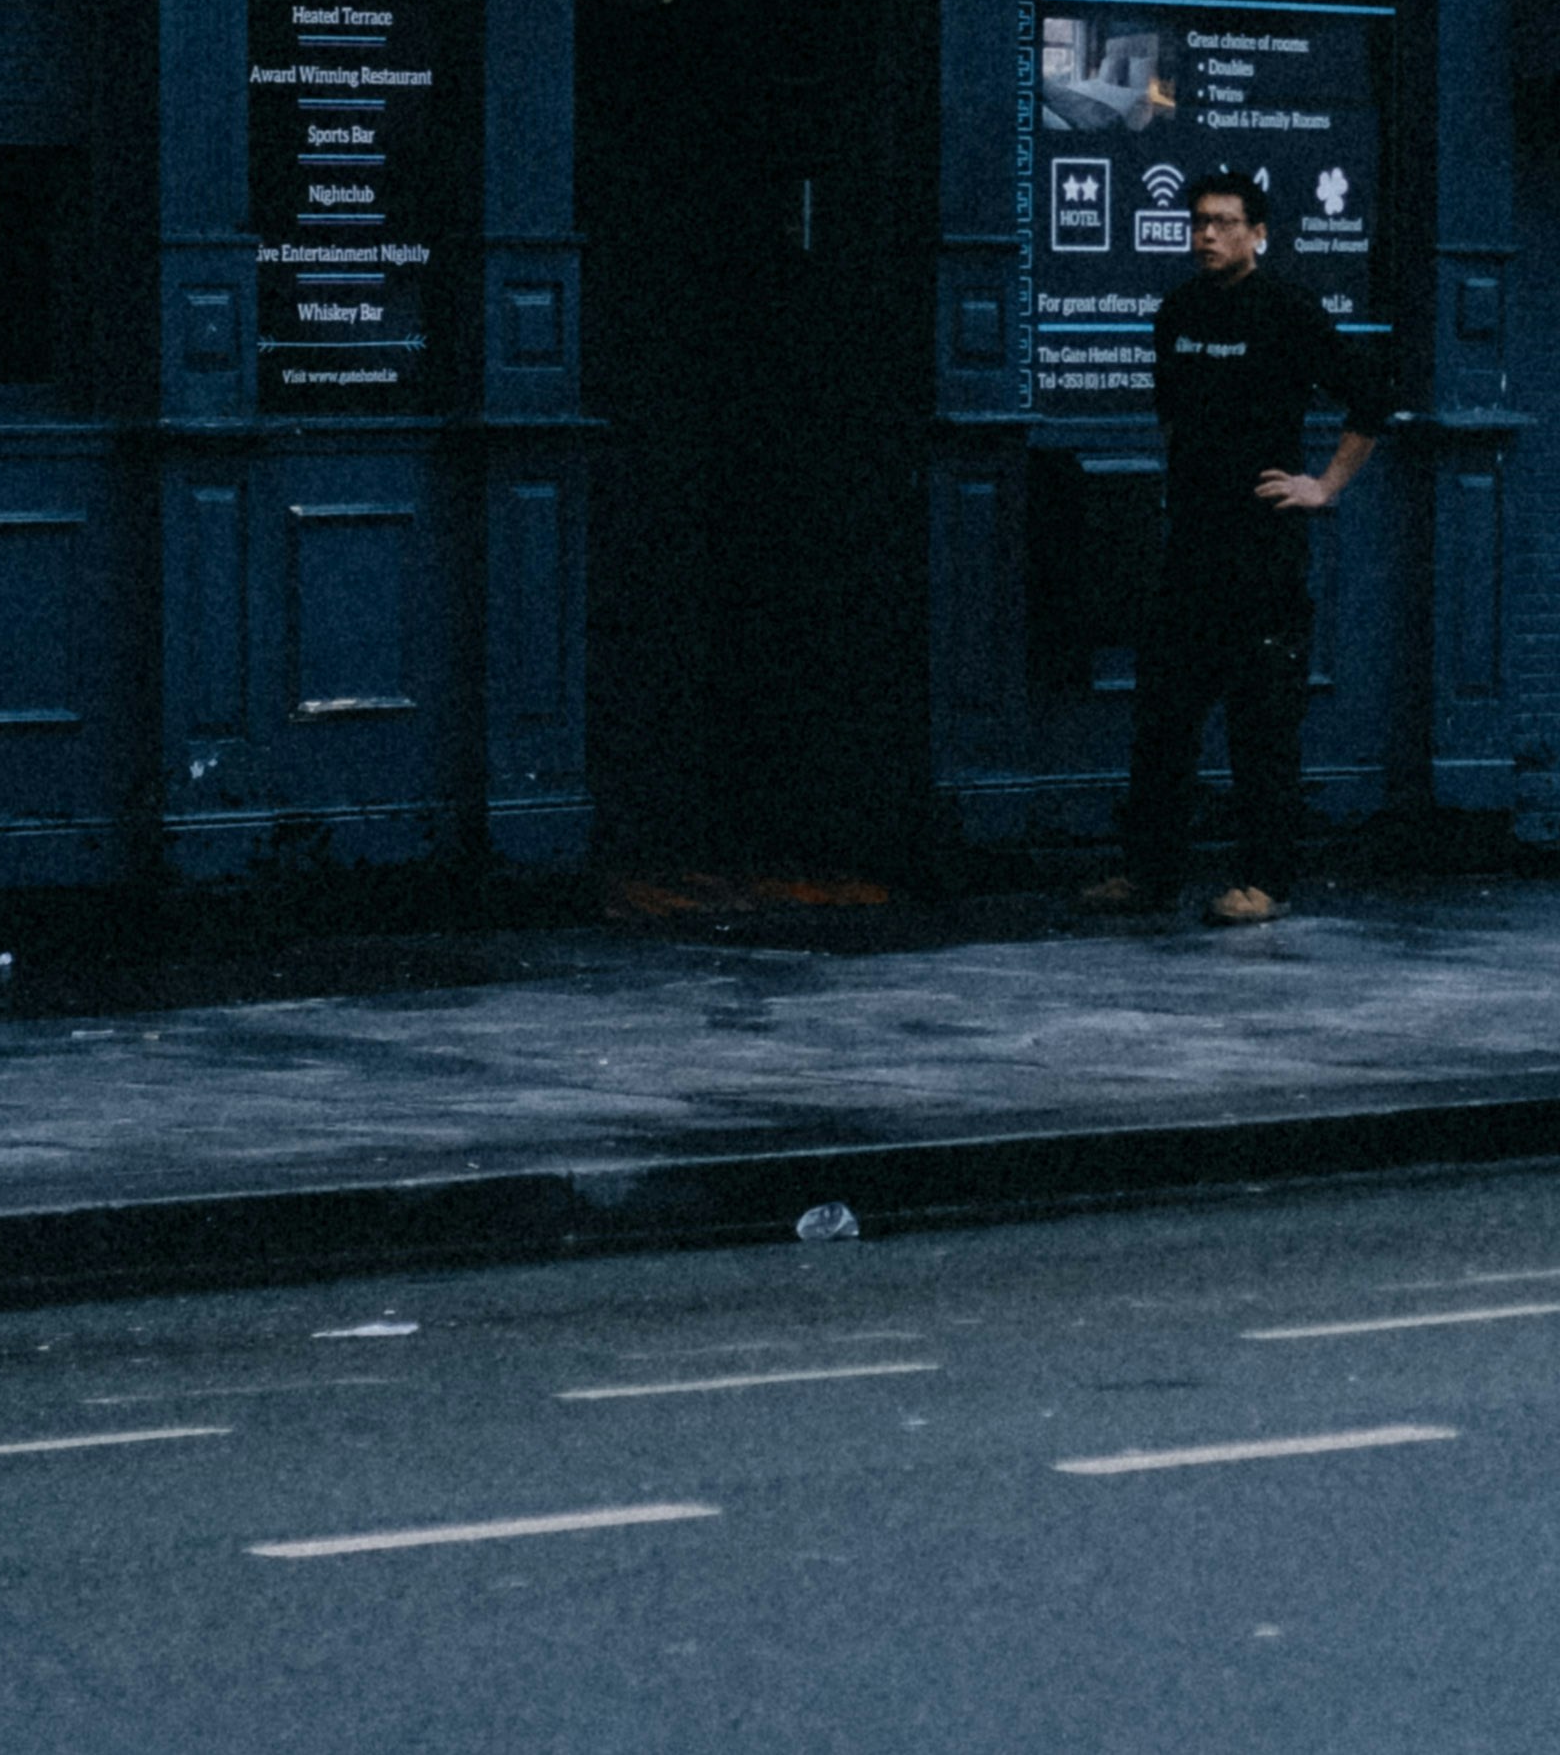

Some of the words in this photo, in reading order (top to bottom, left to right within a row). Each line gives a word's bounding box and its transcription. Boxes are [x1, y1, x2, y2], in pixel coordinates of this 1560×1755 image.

[292, 5, 340, 25] Heated
[341, 7, 393, 27] Terrace
[249, 65, 297, 85] Award
[298, 65, 360, 88] Winning
[360, 66, 432, 86] Restaurant
[1208, 57, 1254, 77] Doubles
[1207, 84, 1246, 103] Twins
[1207, 109, 1239, 130] Quad
[1251, 110, 1290, 131] Family
[307, 125, 350, 147] Sports
[351, 125, 376, 144] Bar
[308, 184, 376, 206] Nightclub
[1060, 209, 1101, 228] HOTEL
[1141, 221, 1184, 241] FREE
[255, 243, 279, 263] ive
[280, 243, 378, 263] Entertainment
[379, 243, 430, 265] Nightly
[297, 302, 359, 325] Whiskey
[359, 303, 385, 322] Bar
